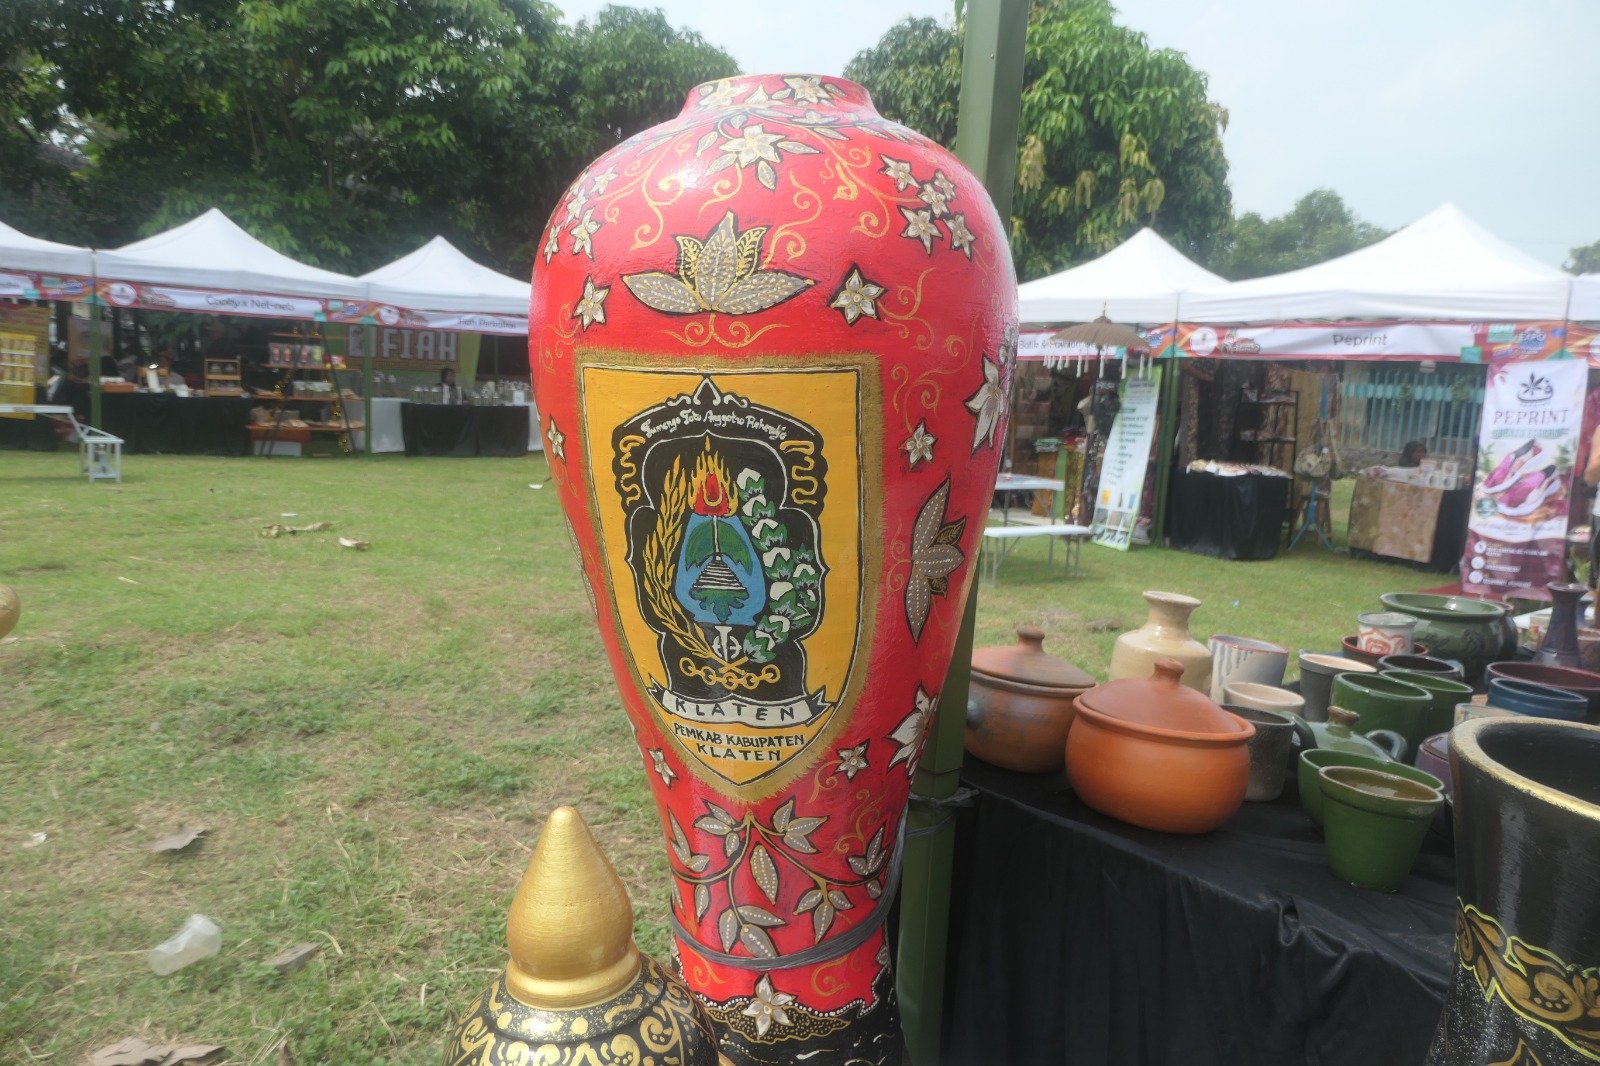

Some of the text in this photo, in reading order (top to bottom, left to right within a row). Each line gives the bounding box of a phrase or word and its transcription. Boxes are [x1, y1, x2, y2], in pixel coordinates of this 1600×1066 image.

[1333, 333, 1387, 347] Peprint
[1494, 409, 1568, 425] PEPRINT
[675, 698, 795, 721] KLATEN
[673, 722, 805, 748] PEMKAB KABUPATEN
[696, 743, 781, 761] KLATEN
